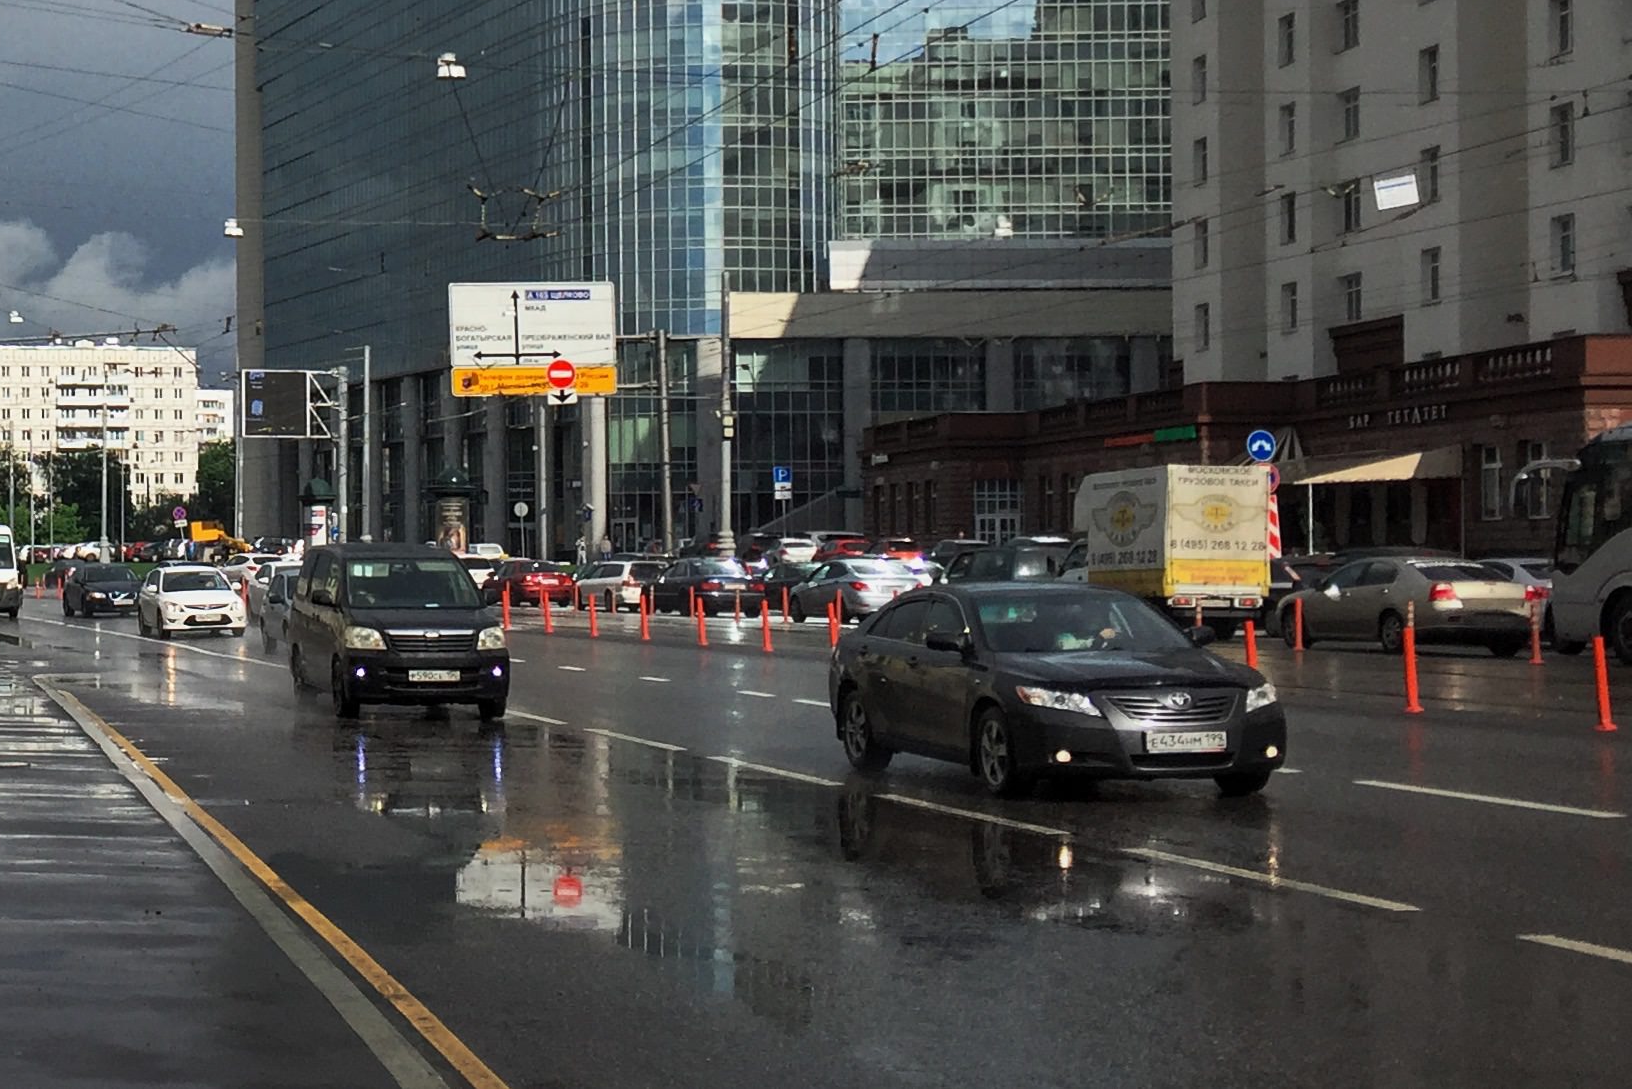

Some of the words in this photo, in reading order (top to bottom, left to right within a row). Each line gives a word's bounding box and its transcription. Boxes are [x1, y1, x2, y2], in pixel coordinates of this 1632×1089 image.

[778, 468, 788, 482] P
[1178, 477, 1225, 486] ГРУЗОВОЕ
[1229, 477, 1259, 487] ТАКСИ
[1180, 539, 1208, 550] (495)
[1211, 540, 1231, 550] 268
[1234, 541, 1248, 550] 12
[1251, 541, 1264, 551] 28
